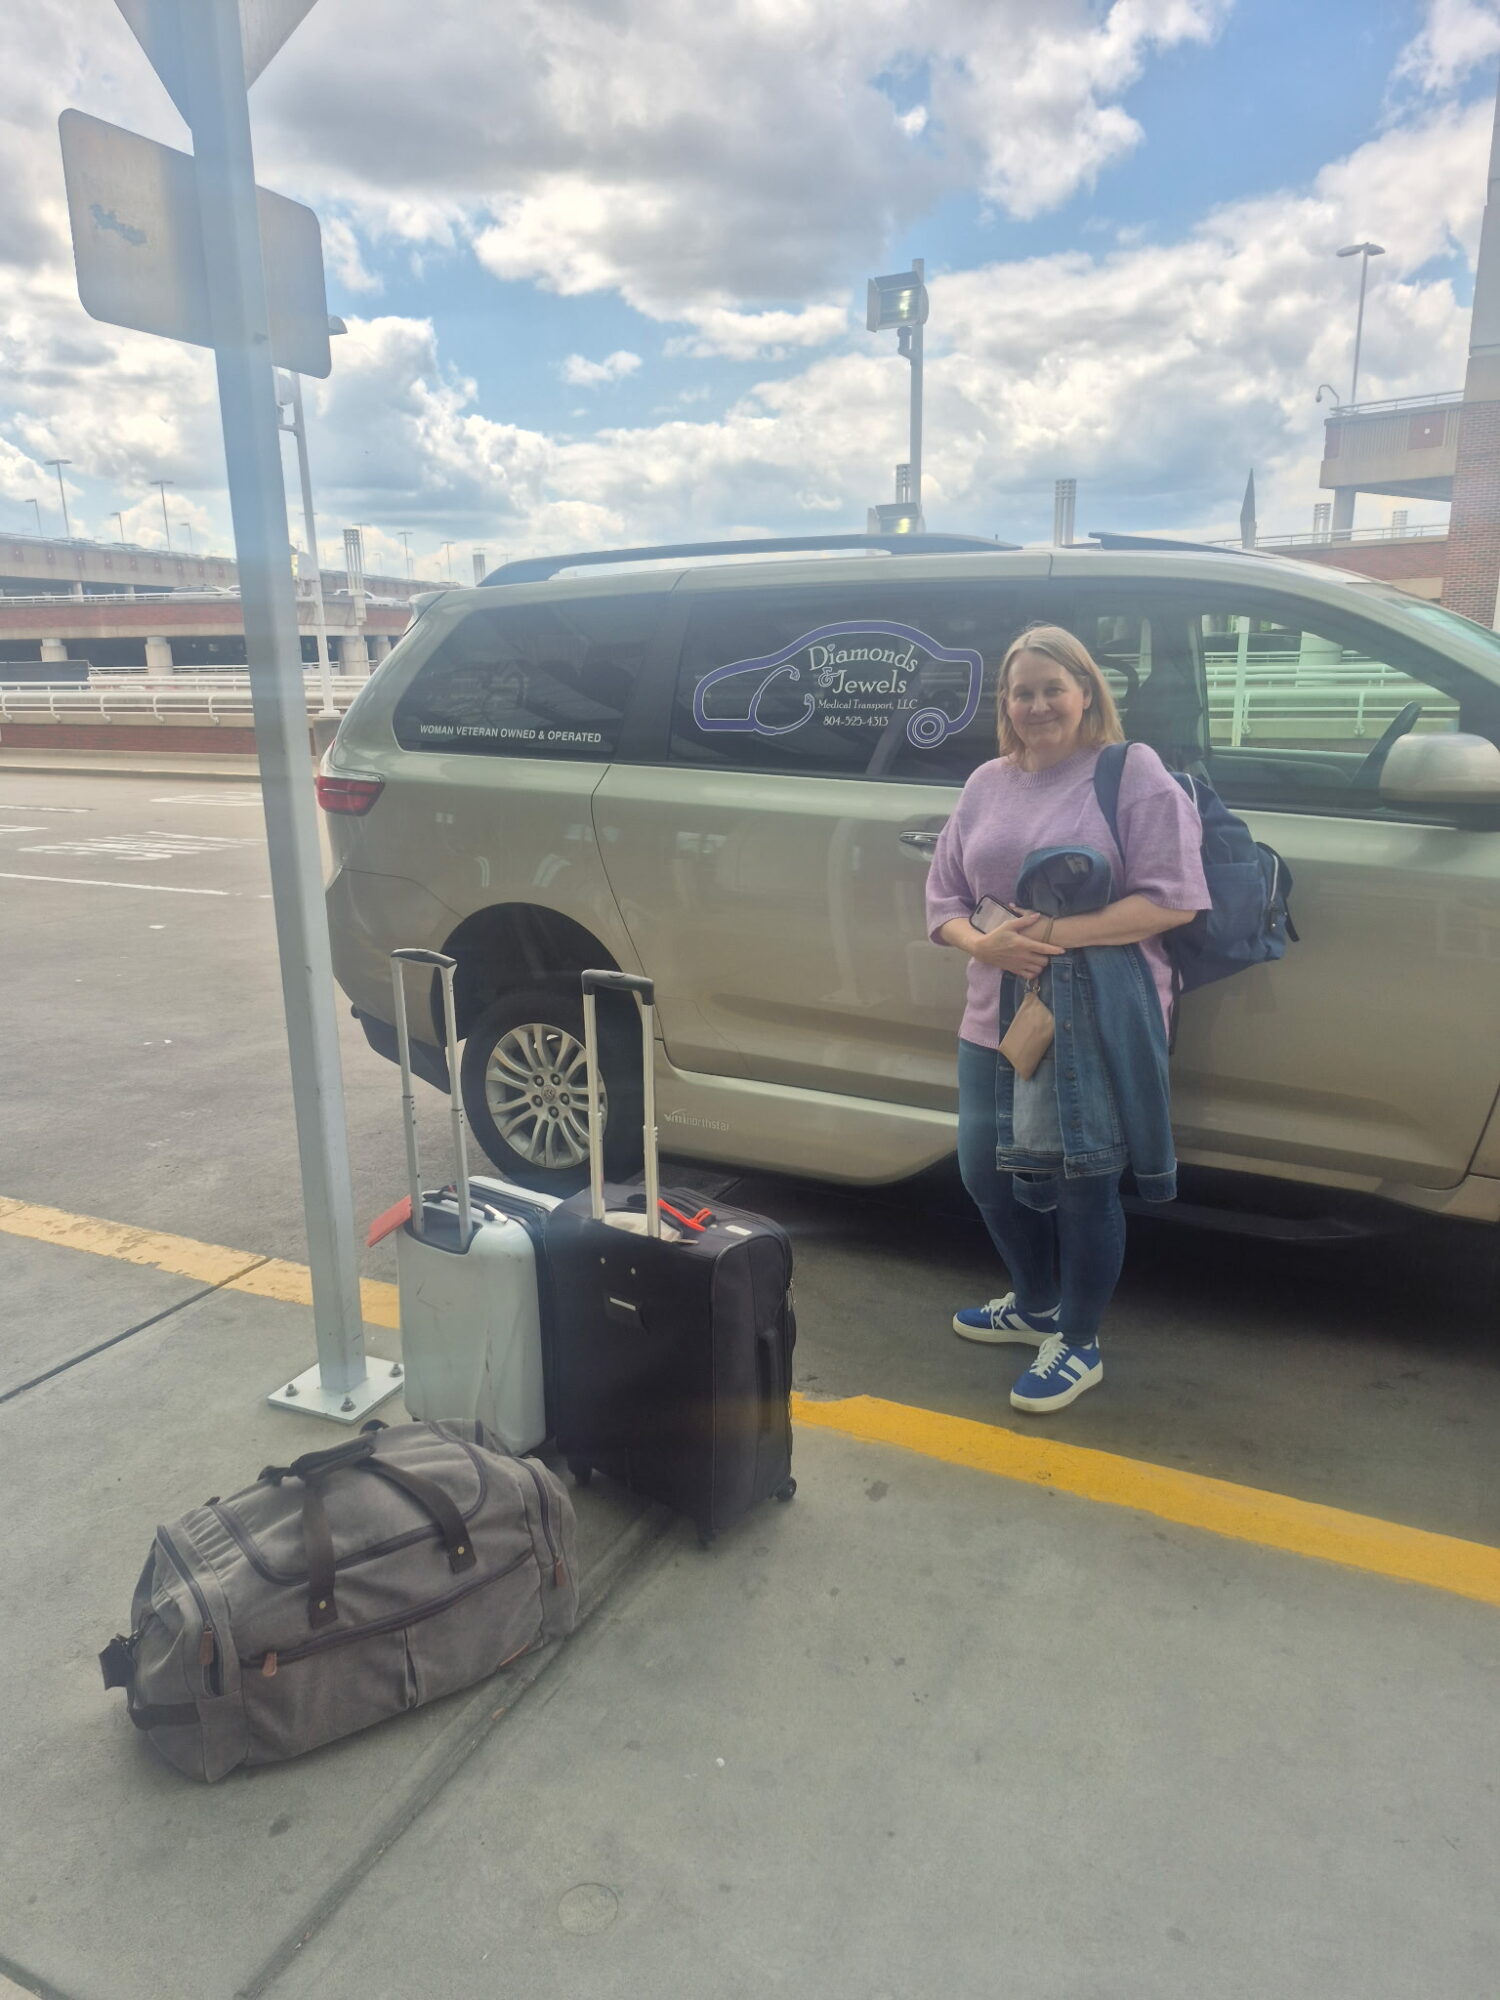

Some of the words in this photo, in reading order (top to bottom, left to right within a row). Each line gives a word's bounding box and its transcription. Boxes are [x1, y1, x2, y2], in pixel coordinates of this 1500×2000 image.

[808, 644, 918, 672] Diamonds
[818, 667, 841, 688] &
[832, 669, 907, 694] Jewels
[818, 699, 852, 710] Medical
[853, 699, 894, 711] Transport,
[897, 699, 918, 709] LLC
[823, 716, 889, 727] 804-525-4313
[420, 725, 454, 735] WOMAN
[456, 726, 499, 737] VETERAN
[500, 728, 536, 739] OWNED
[538, 730, 545, 740] &
[547, 731, 602, 743] OPERATED
